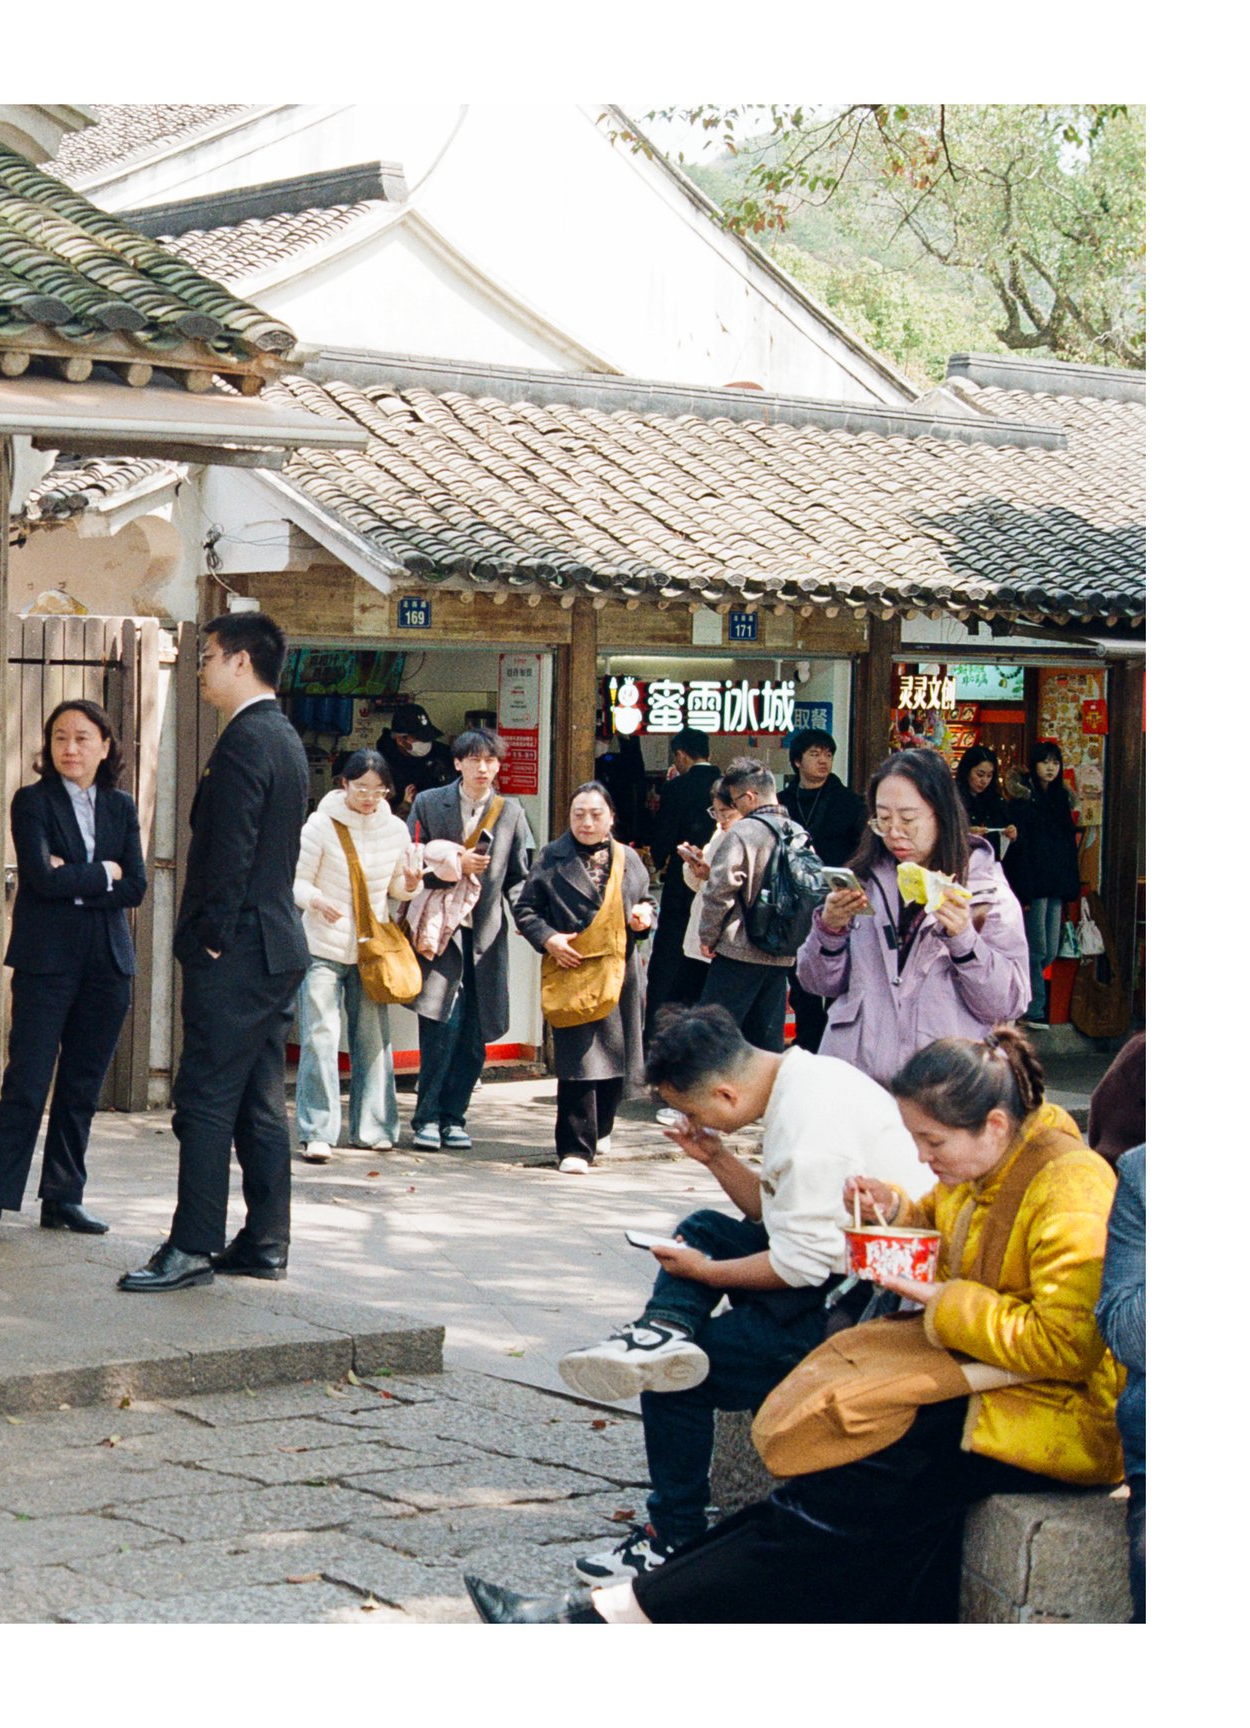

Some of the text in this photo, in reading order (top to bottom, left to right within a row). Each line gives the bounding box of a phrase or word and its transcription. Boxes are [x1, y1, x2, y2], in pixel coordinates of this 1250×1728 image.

[405, 610, 425, 625] 169
[735, 624, 752, 637] 171
[646, 679, 795, 733] 蜜雪冰城
[794, 707, 828, 731] 取餐
